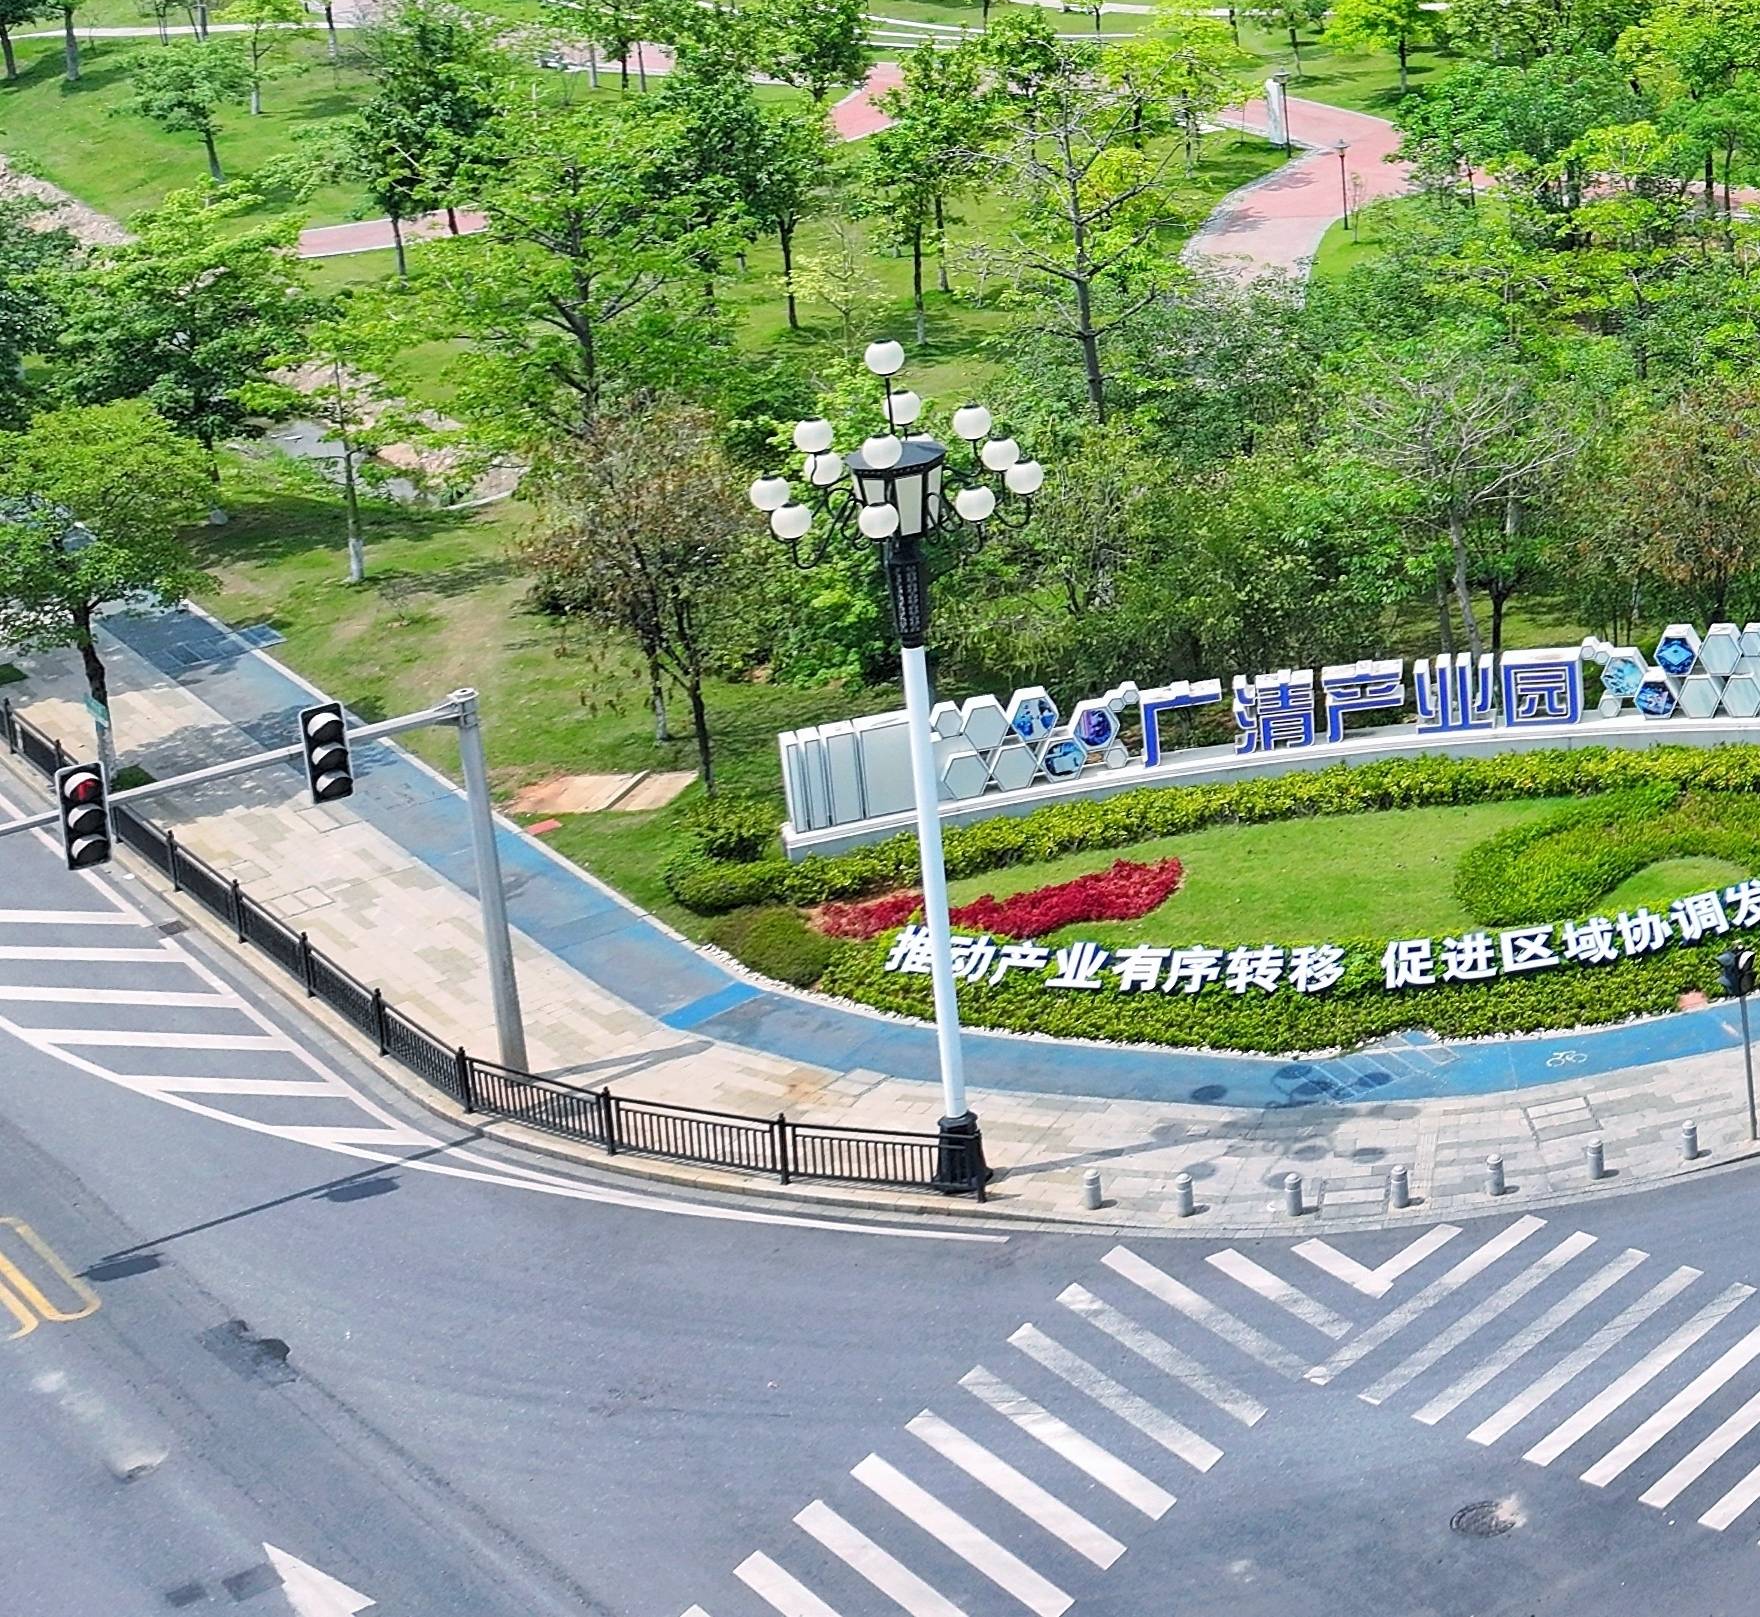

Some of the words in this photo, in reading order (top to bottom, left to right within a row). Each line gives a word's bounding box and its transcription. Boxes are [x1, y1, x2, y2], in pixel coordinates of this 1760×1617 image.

[1139, 646, 1582, 768] 广清产业园
[883, 923, 1348, 997] 推动产业有序转移
